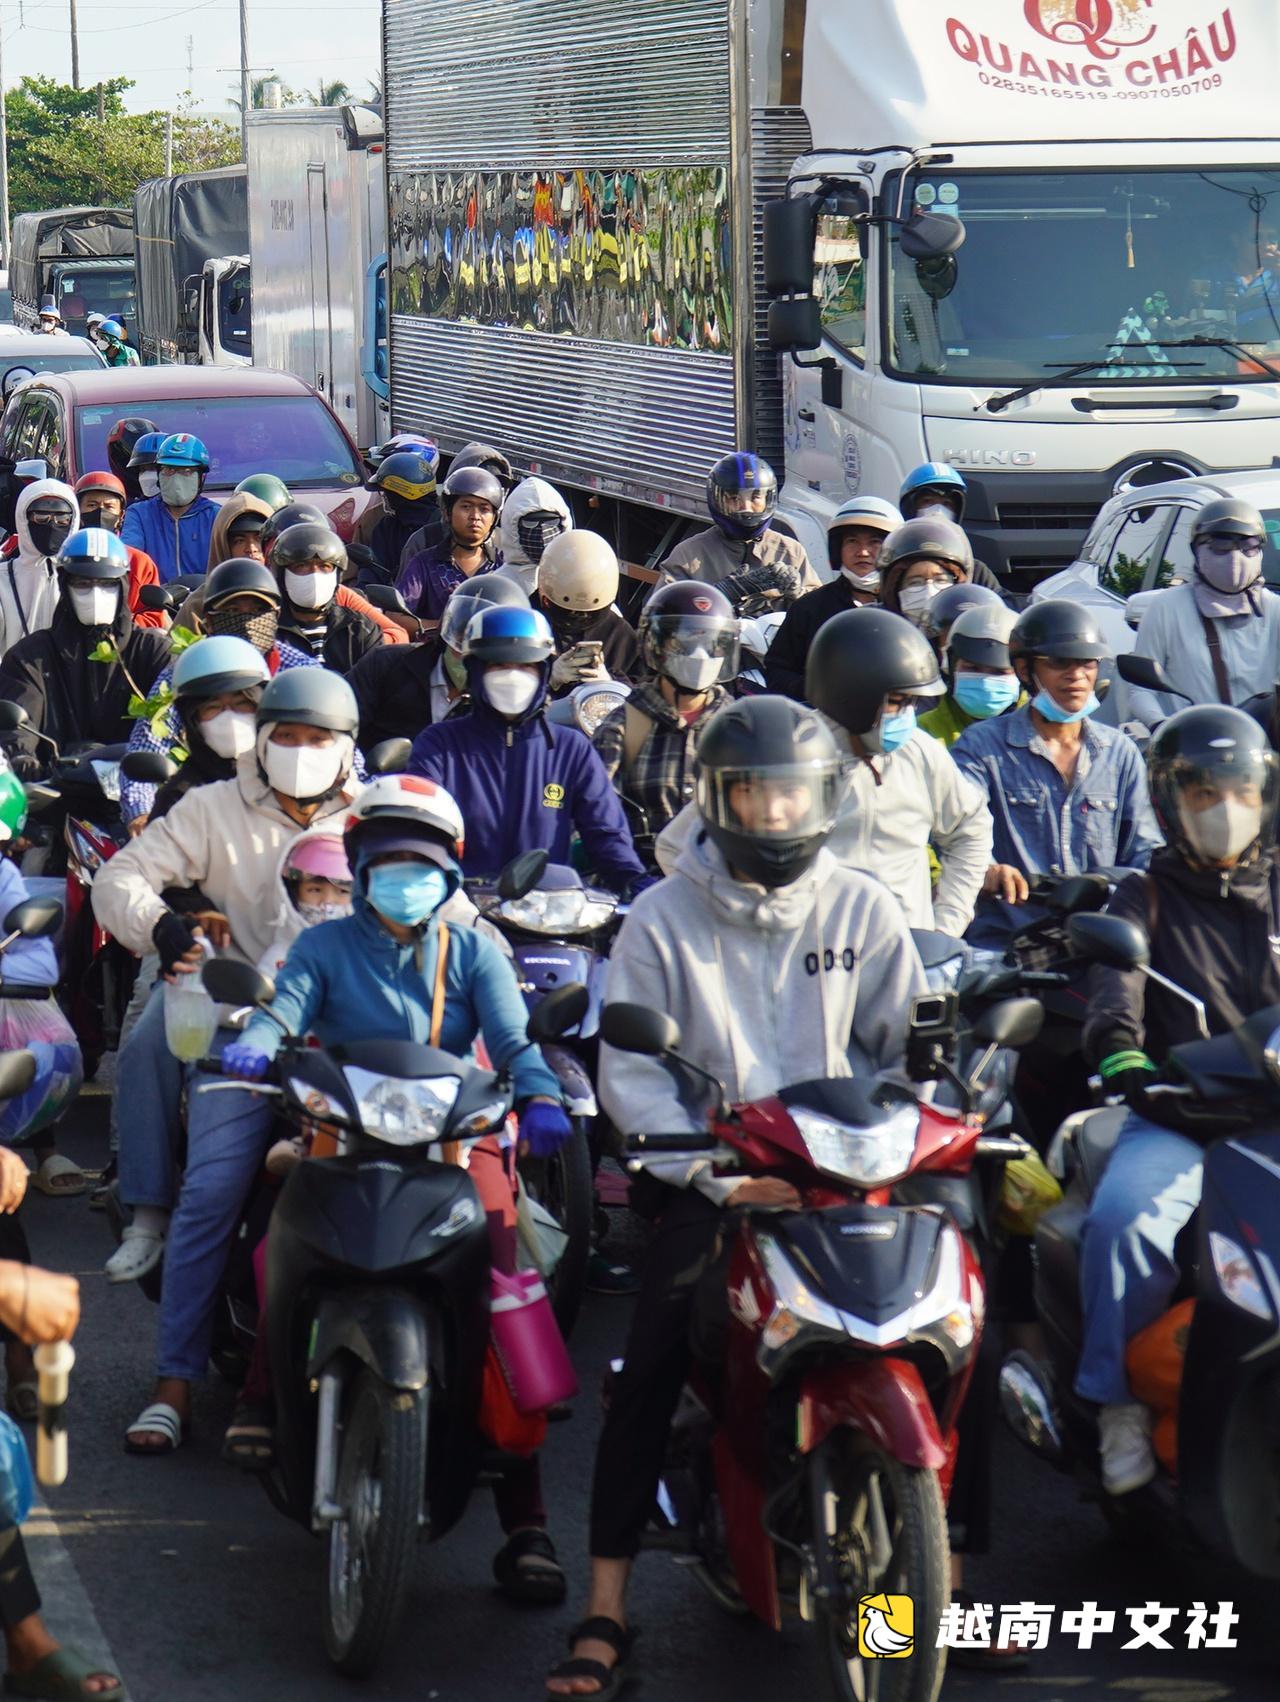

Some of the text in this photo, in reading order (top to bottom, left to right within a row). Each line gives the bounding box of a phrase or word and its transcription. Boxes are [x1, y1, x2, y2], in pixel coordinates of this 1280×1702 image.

[945, 8, 1238, 88] QUANG CHÂU
[942, 449, 1037, 466] HINO
